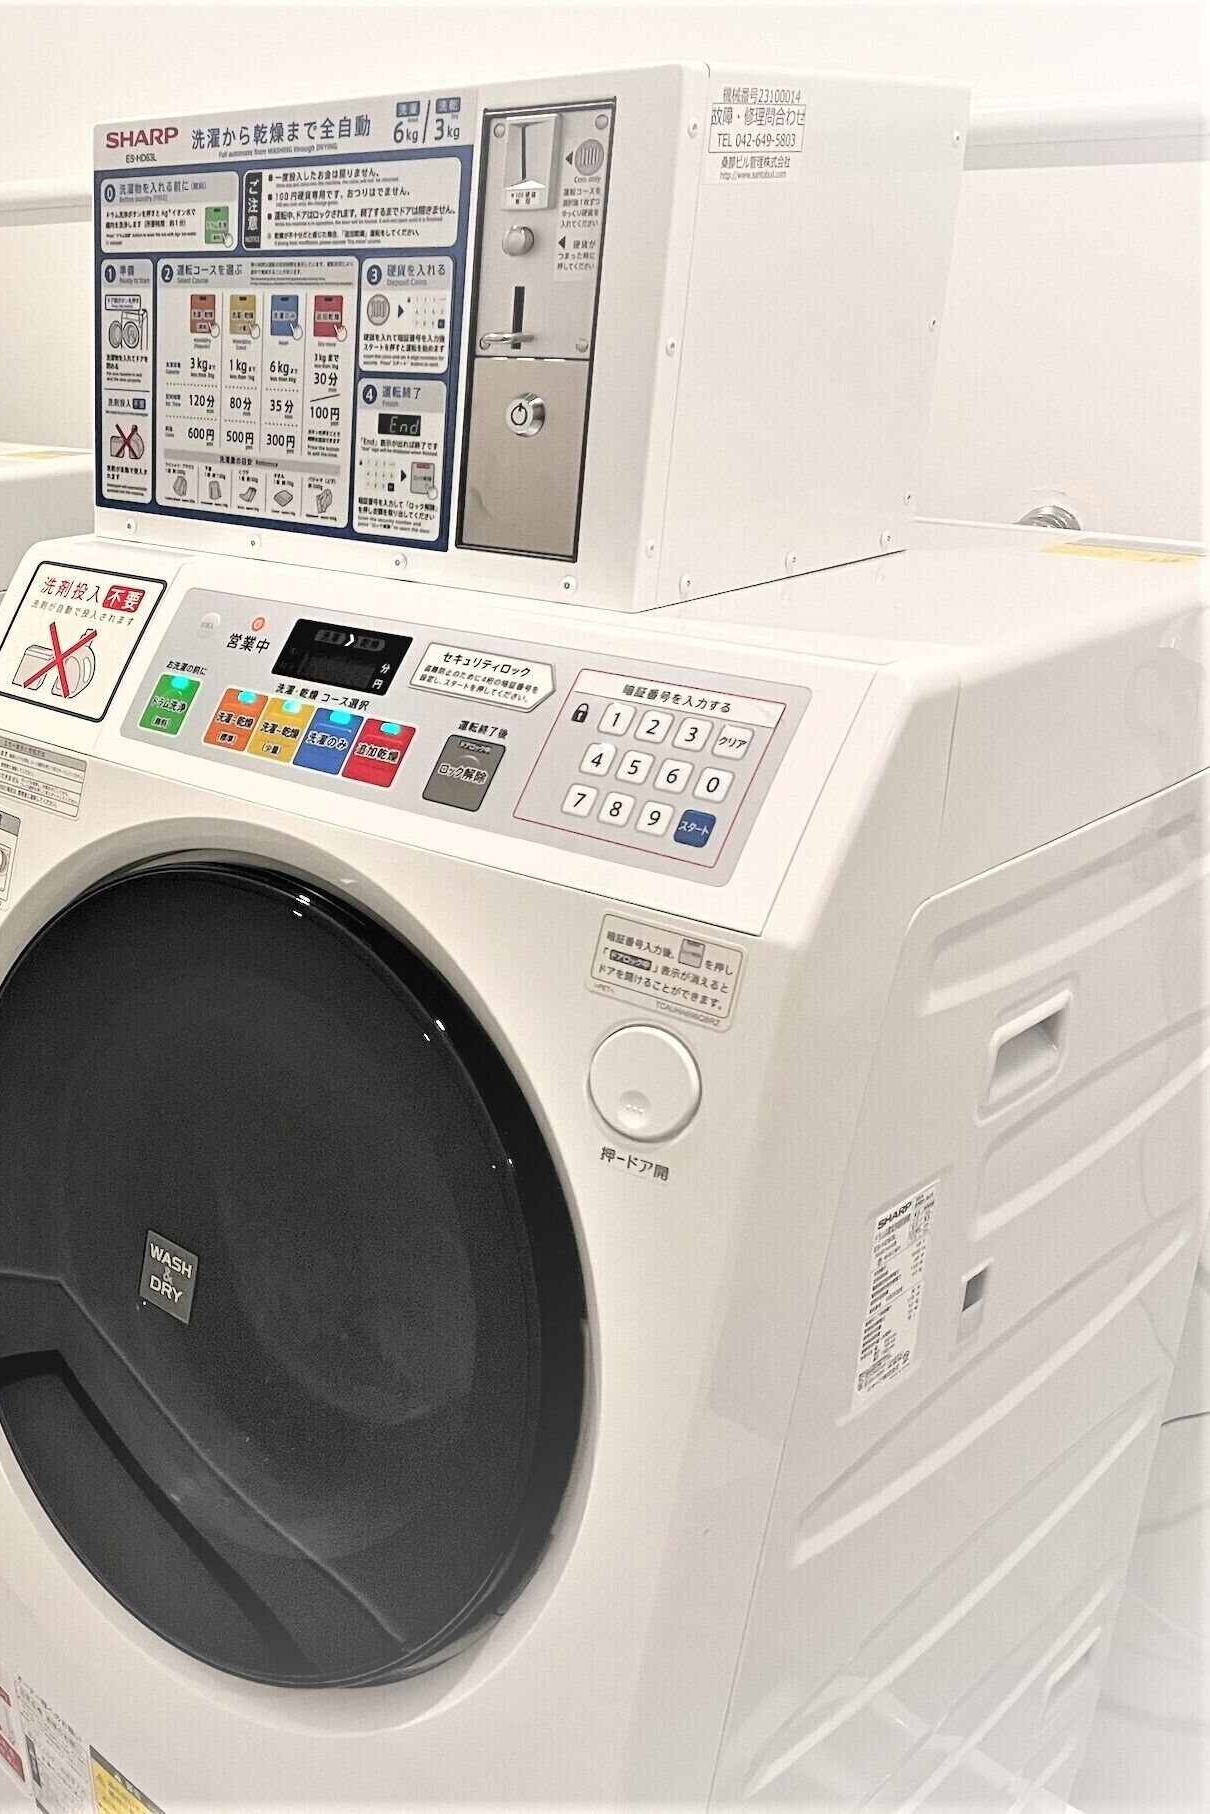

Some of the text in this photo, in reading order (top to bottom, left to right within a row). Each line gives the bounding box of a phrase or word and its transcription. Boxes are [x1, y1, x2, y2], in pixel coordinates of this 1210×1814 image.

[723, 86, 801, 104] 機械番号23100014
[711, 106, 806, 126] 故障・修理問合わせ
[106, 127, 179, 148] SHARP
[192, 114, 371, 150] 洗濯から乾燥まで全自動
[717, 133, 796, 147] TEL 042-649-5803
[387, 264, 446, 277] 硬貨を入れる
[382, 386, 421, 399] 運転終了
[189, 394, 215, 408] 120分
[230, 397, 252, 410] 80分
[270, 400, 294, 413] 35分
[310, 406, 340, 421] 100円
[389, 415, 419, 435] End
[188, 427, 215, 441] 600円
[226, 430, 254, 445] 500円
[266, 433, 295, 448] 300円
[41, 576, 143, 611] 洗剤投入 不要
[31, 600, 135, 627] 洗剤が自動で投入されます
[227, 632, 270, 654] 営業中
[166, 660, 207, 676] お洗濯の前に
[380, 663, 390, 674] 分
[443, 652, 531, 677] セキュリティロック
[372, 679, 383, 690] 円
[152, 695, 187, 713] ドラム洗浄
[321, 693, 370, 711] コース選択
[622, 684, 732, 713] 暗証番号を入力する
[612, 712, 621, 727] 1
[646, 719, 660, 735] 2
[458, 719, 508, 739] 運転終了後
[685, 727, 698, 742] 3
[307, 732, 348, 750] 洗濯のみ
[718, 736, 748, 750] クリア
[357, 744, 399, 762] 追加乾燥
[591, 752, 604, 768] 4
[439, 765, 487, 784] ロック解除
[627, 760, 641, 775] 5
[666, 768, 680, 784] 6
[706, 777, 719, 793] 0
[574, 793, 587, 808] 7
[609, 801, 623, 817] 8
[647, 810, 661, 826] 9
[678, 820, 710, 836] スタート
[705, 959, 733, 976] を押し
[598, 964, 722, 1011] ドアを開けることができます。
[877, 1201, 913, 1230] SHARP
[150, 1242, 192, 1279] WASH
[149, 1274, 184, 1303] DRY
